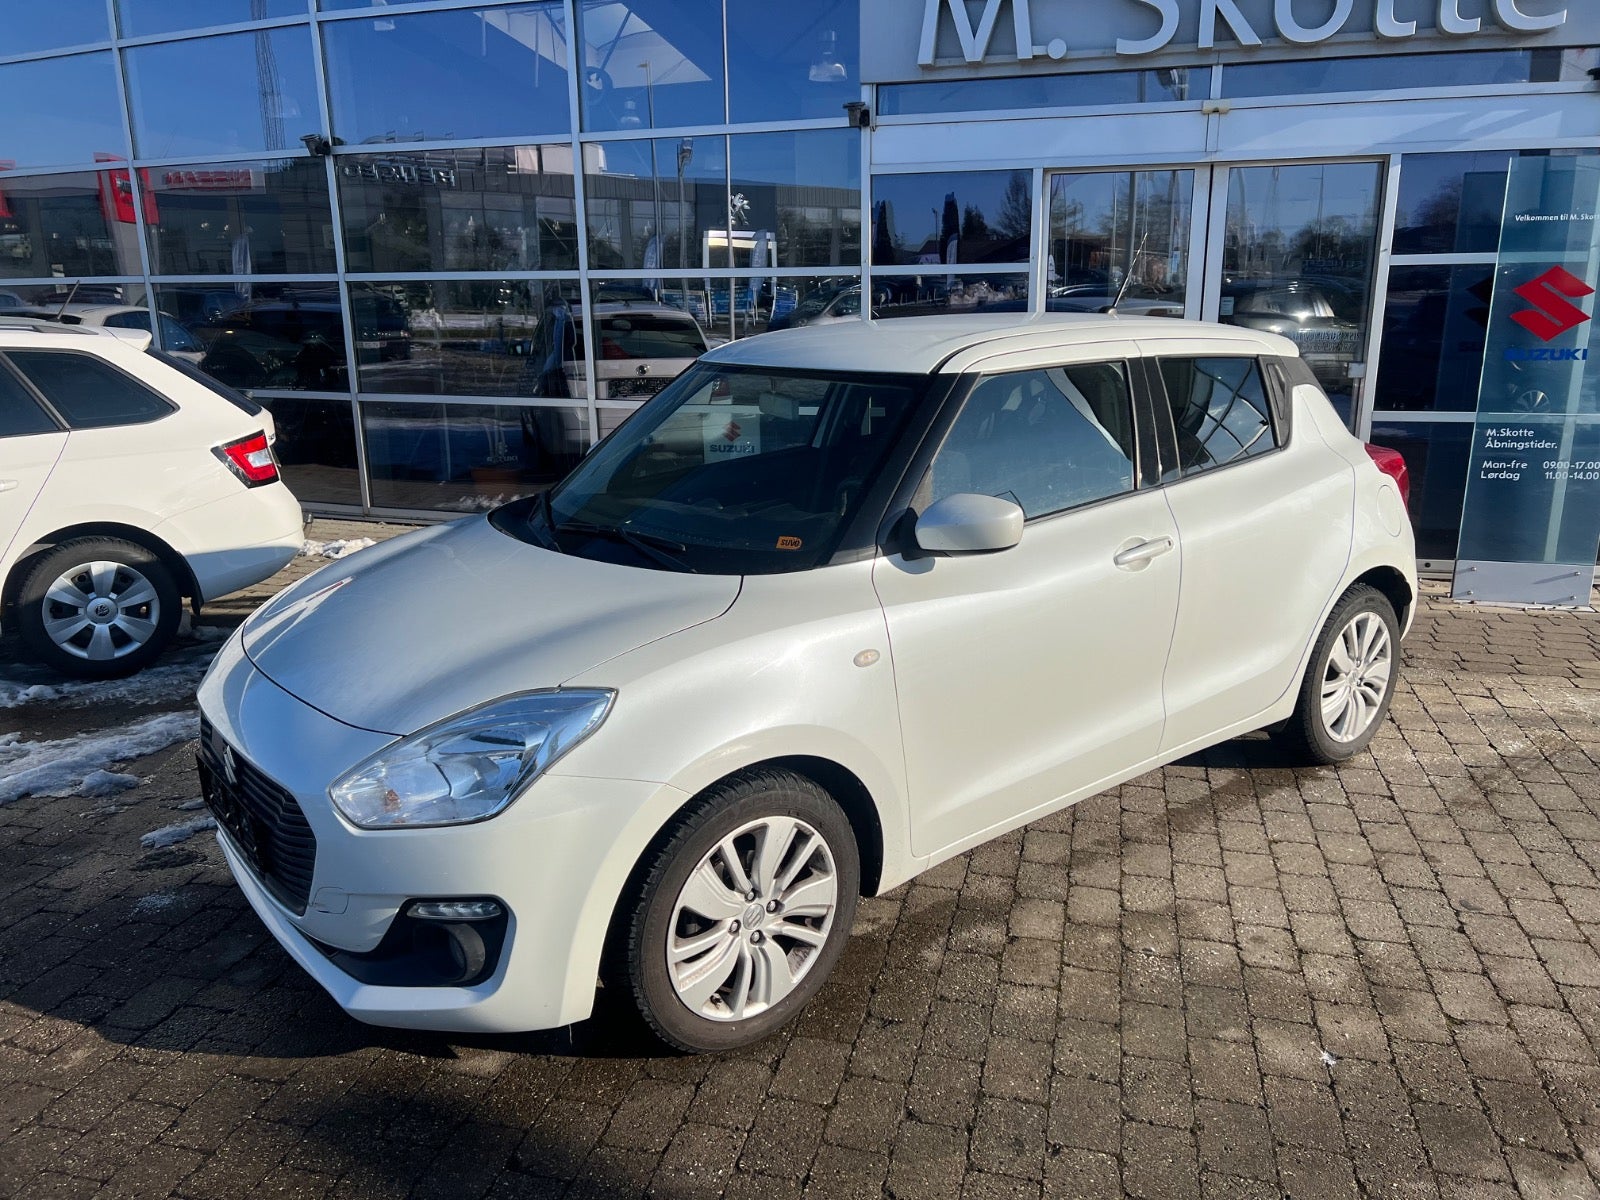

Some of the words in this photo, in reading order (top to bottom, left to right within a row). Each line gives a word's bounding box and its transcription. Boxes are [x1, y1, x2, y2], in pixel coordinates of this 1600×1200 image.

[1560, 213, 1568, 221] til
[1504, 348, 1588, 360] UZUKI
[1485, 437, 1558, 450] Åbningstider.
[1482, 460, 1528, 469] Man-fre
[1480, 470, 1520, 481] Lørdag
